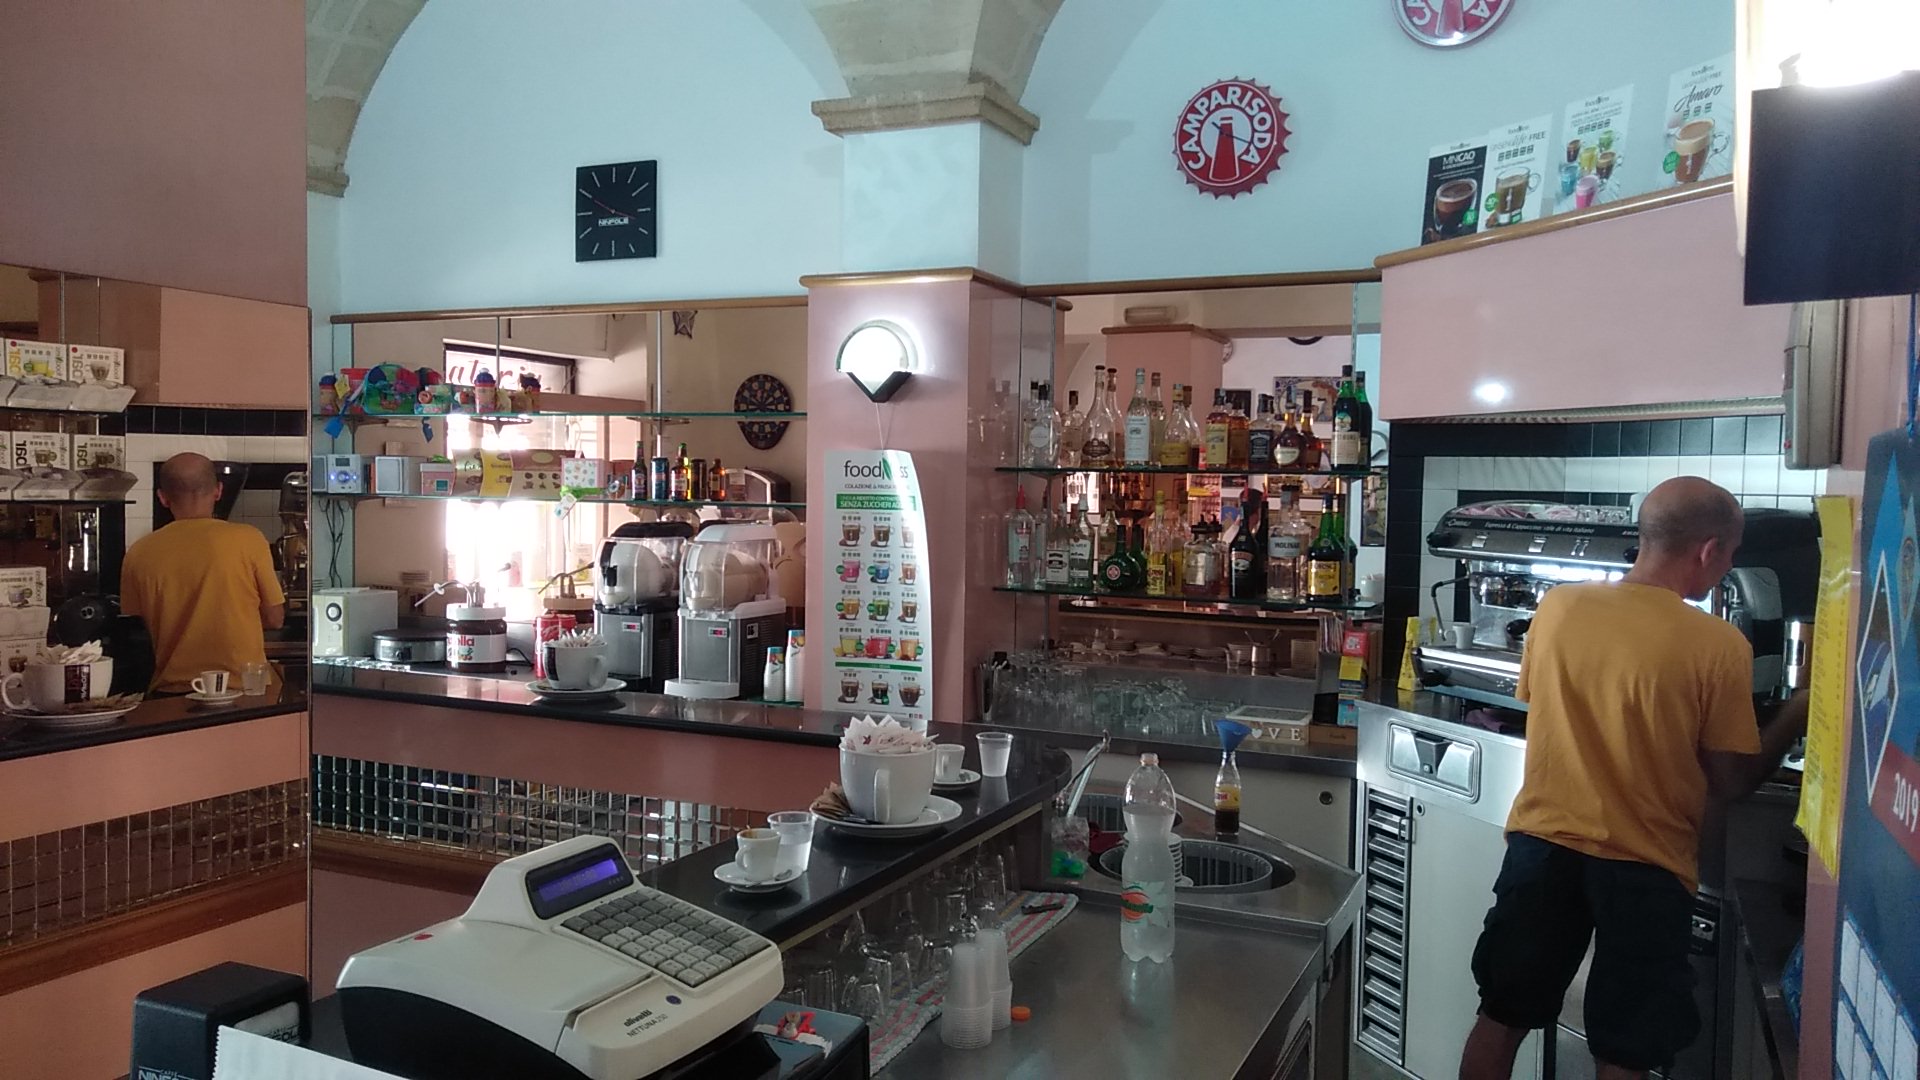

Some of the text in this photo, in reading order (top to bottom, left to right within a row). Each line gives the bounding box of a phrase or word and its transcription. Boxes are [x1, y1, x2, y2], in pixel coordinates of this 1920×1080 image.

[1673, 84, 1724, 113] Amaro
[1182, 86, 1272, 170] CAMPARISODA
[1893, 772, 1919, 833] 2019
[623, 1009, 653, 1027] olivetti
